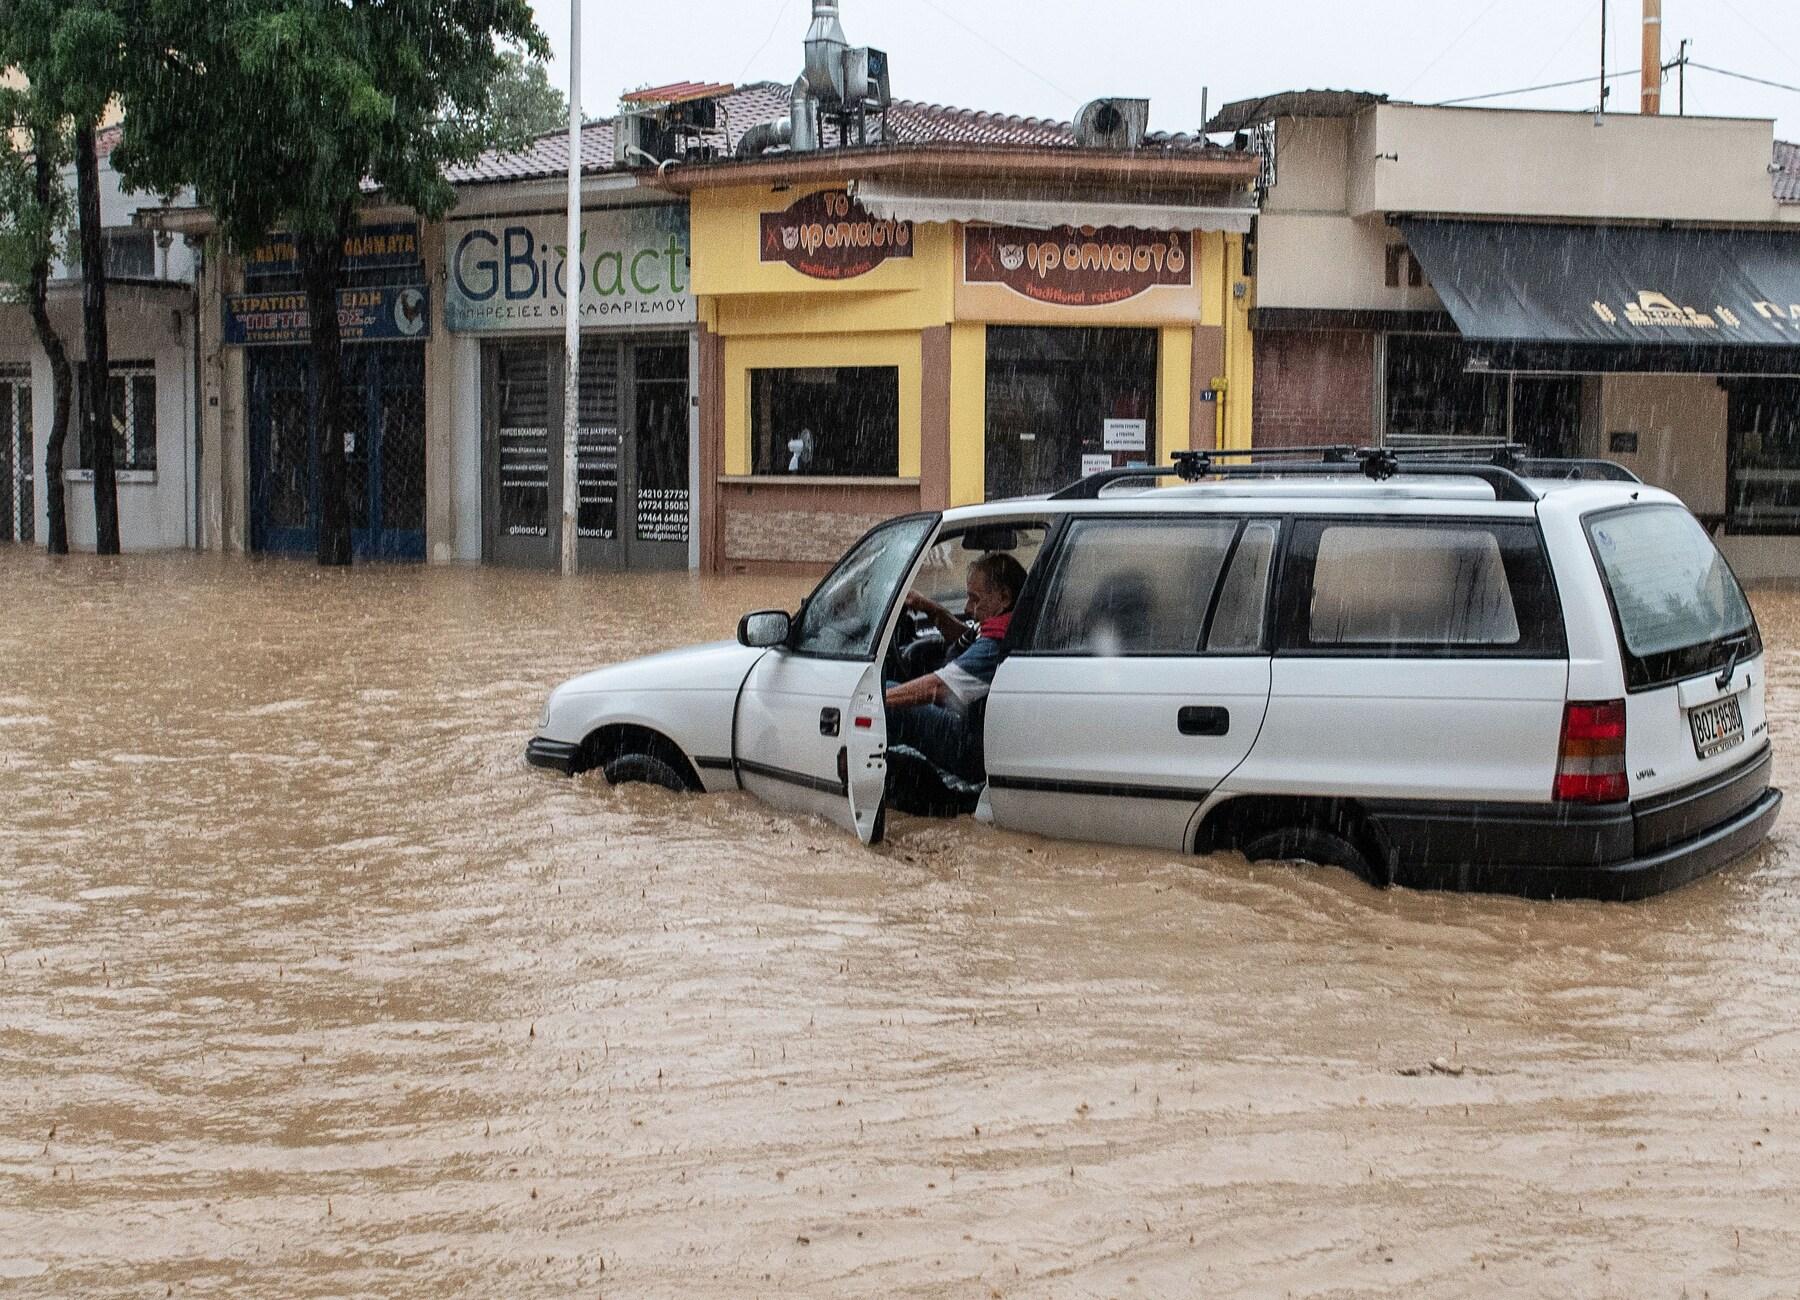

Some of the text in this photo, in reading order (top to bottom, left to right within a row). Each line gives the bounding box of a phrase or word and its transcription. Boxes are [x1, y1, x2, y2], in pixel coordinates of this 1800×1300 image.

[341, 292, 382, 307] ΕΙΔΗ
[456, 299, 687, 319] ΥΠΗΡΕΣΙΕΣ ΒΙΚΑΘΑΡΙΣΜΟΥ
[1204, 391, 1212, 401] 17
[637, 489, 689, 499] 24210 27729
[637, 500, 662, 510] 69724
[637, 512, 662, 522] 69464
[578, 527, 613, 538] bioact.gr
